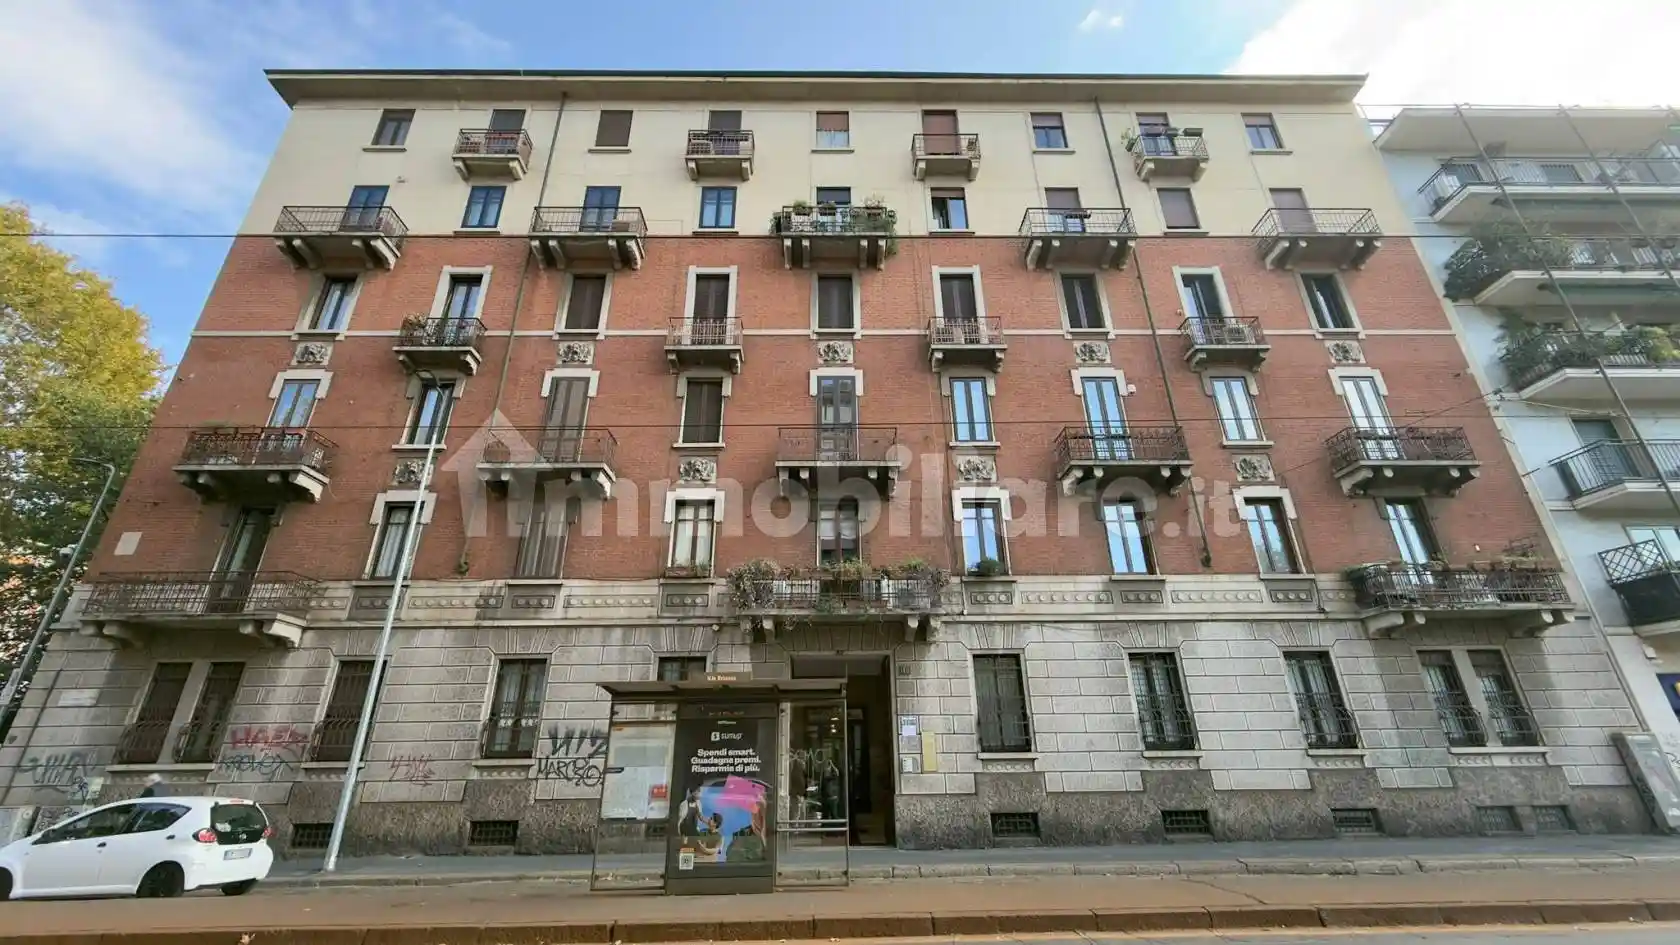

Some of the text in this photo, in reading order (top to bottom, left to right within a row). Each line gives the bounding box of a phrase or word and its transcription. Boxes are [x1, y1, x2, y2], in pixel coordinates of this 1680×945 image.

[697, 748, 756, 757] Spendi smart.
[691, 756, 762, 765] Guadagna premi.
